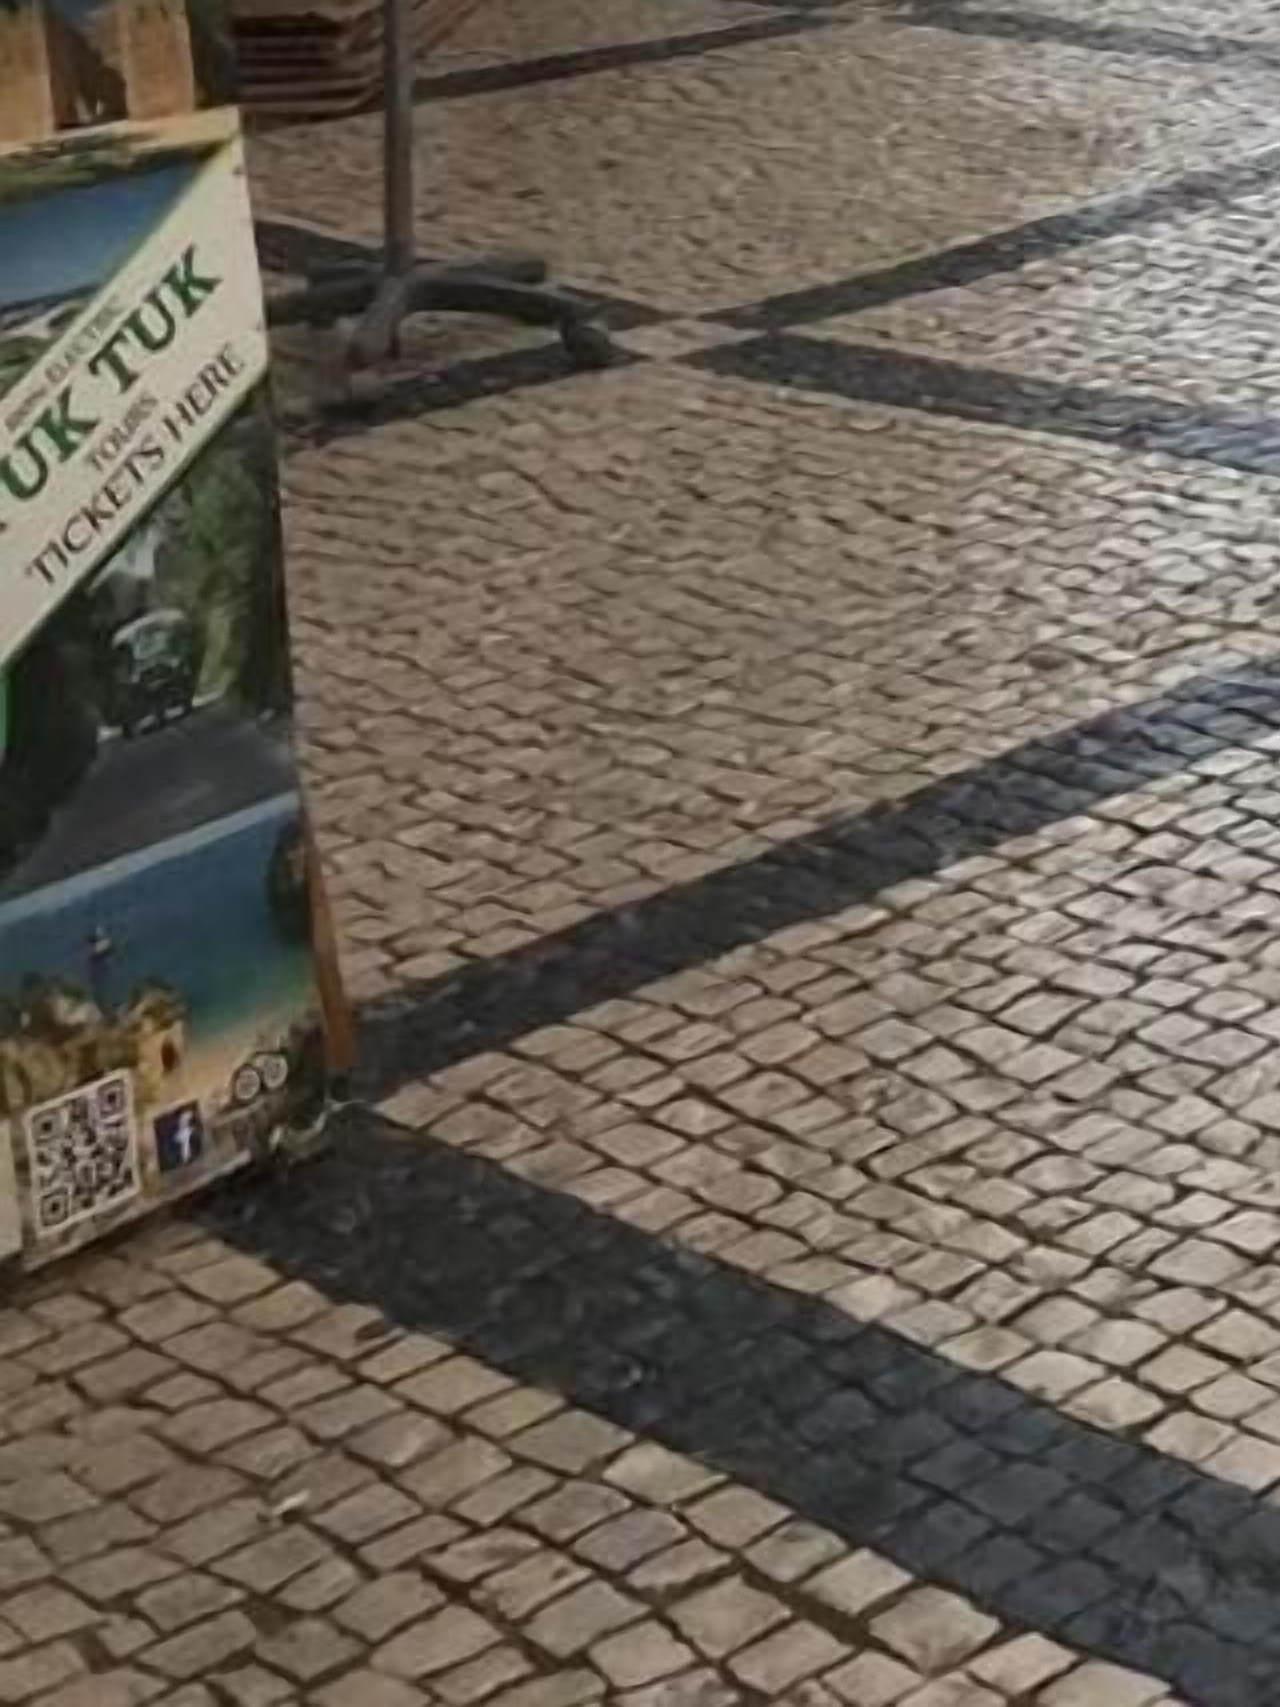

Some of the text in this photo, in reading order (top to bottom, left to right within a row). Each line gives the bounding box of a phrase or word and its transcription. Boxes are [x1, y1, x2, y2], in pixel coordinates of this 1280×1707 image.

[0, 242, 224, 534] UK TUK
[26, 342, 246, 585] TICKETS HERE
[89, 391, 158, 471] TOURS
